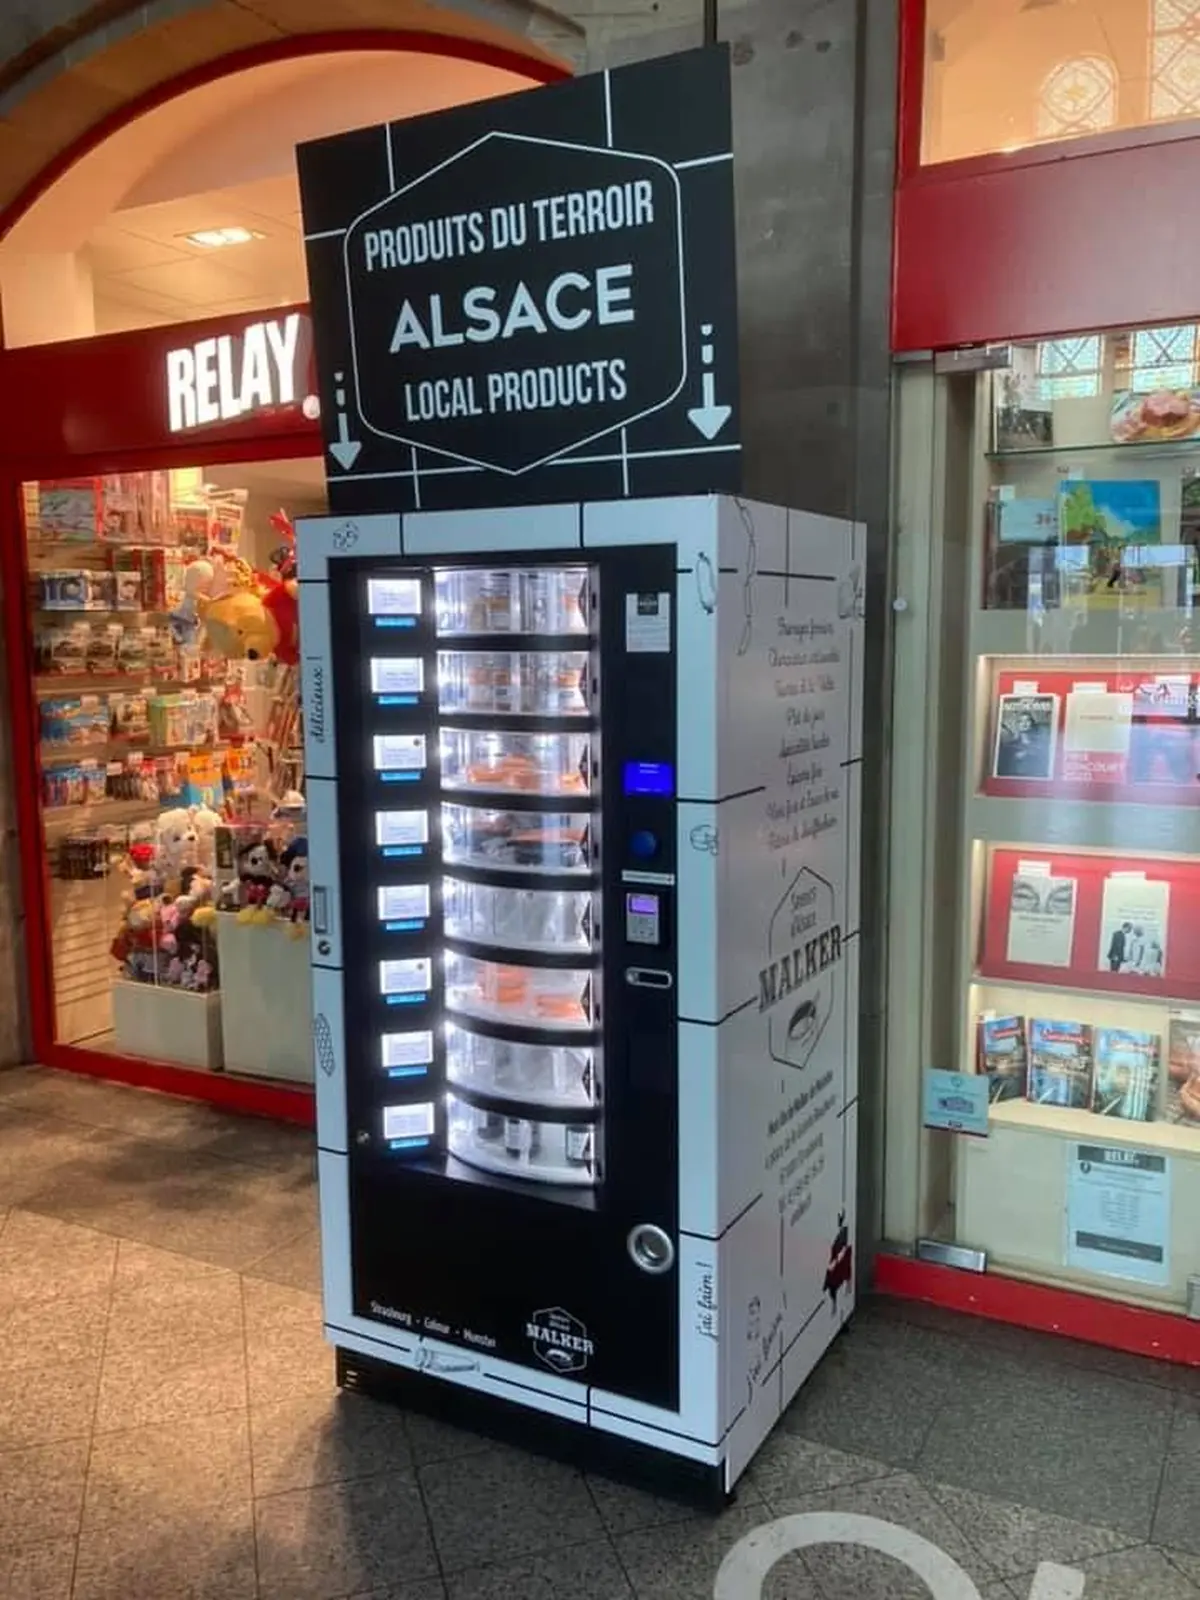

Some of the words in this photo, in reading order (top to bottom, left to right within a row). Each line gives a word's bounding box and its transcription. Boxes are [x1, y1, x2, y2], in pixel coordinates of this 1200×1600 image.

[364, 211, 486, 272] PRODUITS
[491, 202, 527, 249] DU
[532, 180, 654, 242] TERROIR
[388, 263, 635, 354] ALSACE
[167, 312, 300, 433] RELAY
[405, 376, 483, 421] LOCAL
[487, 358, 628, 413] PRODUCTS
[758, 924, 842, 1013] MALKER
[526, 1322, 594, 1355] MALKER
